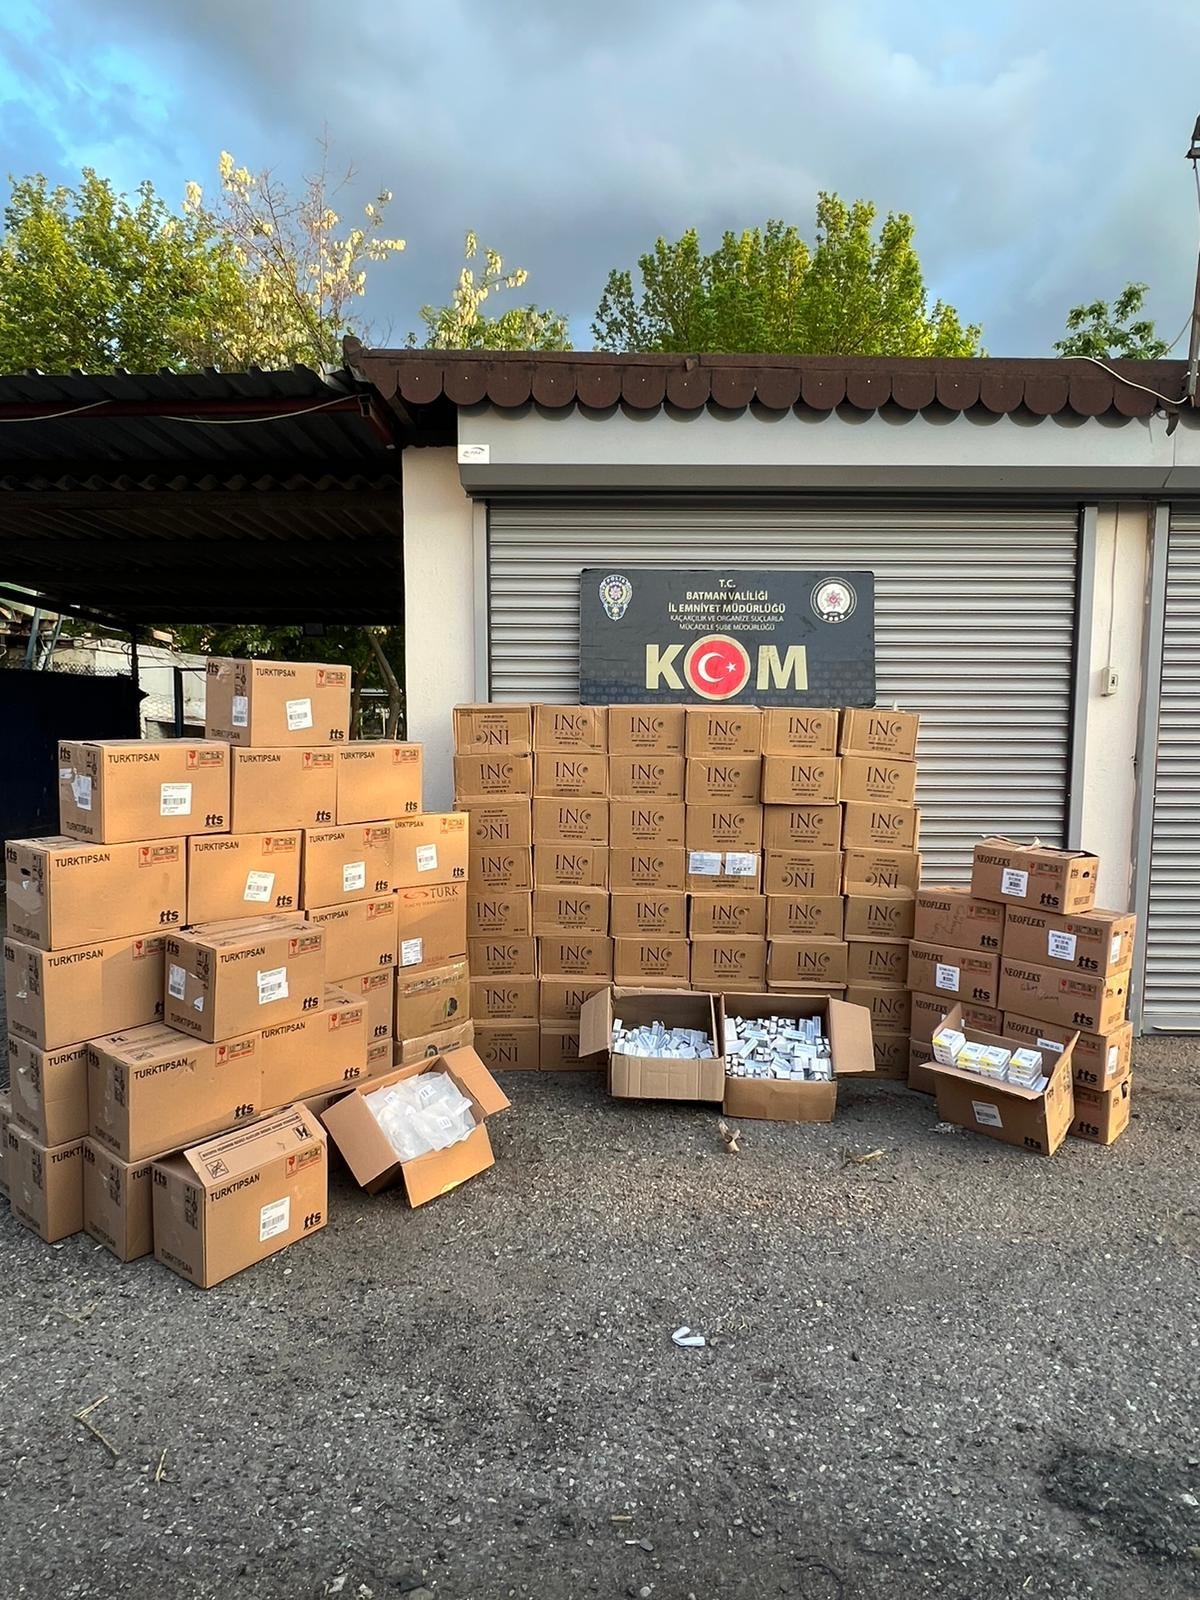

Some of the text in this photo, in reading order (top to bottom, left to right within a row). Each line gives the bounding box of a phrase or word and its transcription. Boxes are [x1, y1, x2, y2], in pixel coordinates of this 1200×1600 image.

[686, 590, 768, 600] BATMAN VALİLİĞİ
[668, 602, 785, 613] İL EMNİYET MÜDÜRLÜĞÜ
[256, 668, 296, 677] TURKTIPSAN
[330, 729, 344, 740] tts
[109, 754, 160, 763] TURKTIPSAN
[340, 752, 375, 760] TURKTIPSAN
[405, 802, 418, 811] tts
[205, 814, 223, 827] tts
[316, 811, 331, 821] tts
[309, 833, 345, 842] TURKTIPSAN
[195, 841, 239, 851] TURKTIPSAN
[56, 854, 110, 867] TURKTIPSAN
[976, 855, 1010, 866] NEOFLEKS
[453, 867, 464, 877] tts
[375, 880, 388, 891] tts
[430, 886, 458, 896] TURK
[276, 895, 292, 907] tts
[918, 899, 951, 911] NEOFLEKS
[1041, 893, 1059, 907] tts
[160, 910, 179, 924] tts
[313, 911, 348, 922] TURKTIPSAN
[1007, 914, 1046, 928] NEOFLEKS
[980, 935, 998, 948] tts
[48, 950, 103, 967] TURKTIPSAN
[220, 947, 265, 963] TURKTIPSAN
[380, 953, 392, 964] tts
[911, 950, 943, 961] NEOFLEKS
[1077, 955, 1098, 970] tts
[1004, 967, 1041, 982] NEOFLEKS
[973, 987, 990, 1000] tts
[303, 997, 318, 1011] tts
[915, 1000, 947, 1013] NEOFLEKS
[1073, 1012, 1093, 1027] tts
[262, 1022, 305, 1038] TURKTIPSAN
[375, 1025, 387, 1037] tts
[1006, 1021, 1044, 1037] NEOFLEKS
[48, 1049, 88, 1066] TURKTIP
[912, 1050, 931, 1062] NEOFL
[134, 1058, 188, 1080] TURKTIPSAN
[344, 1067, 360, 1080] tts
[1077, 1069, 1097, 1083] tts
[234, 1104, 254, 1118] tts
[1078, 1122, 1099, 1136] tts
[1025, 1136, 1041, 1150] tts
[210, 1173, 260, 1202] TURKTIPSAN
[304, 1212, 321, 1230] tts
